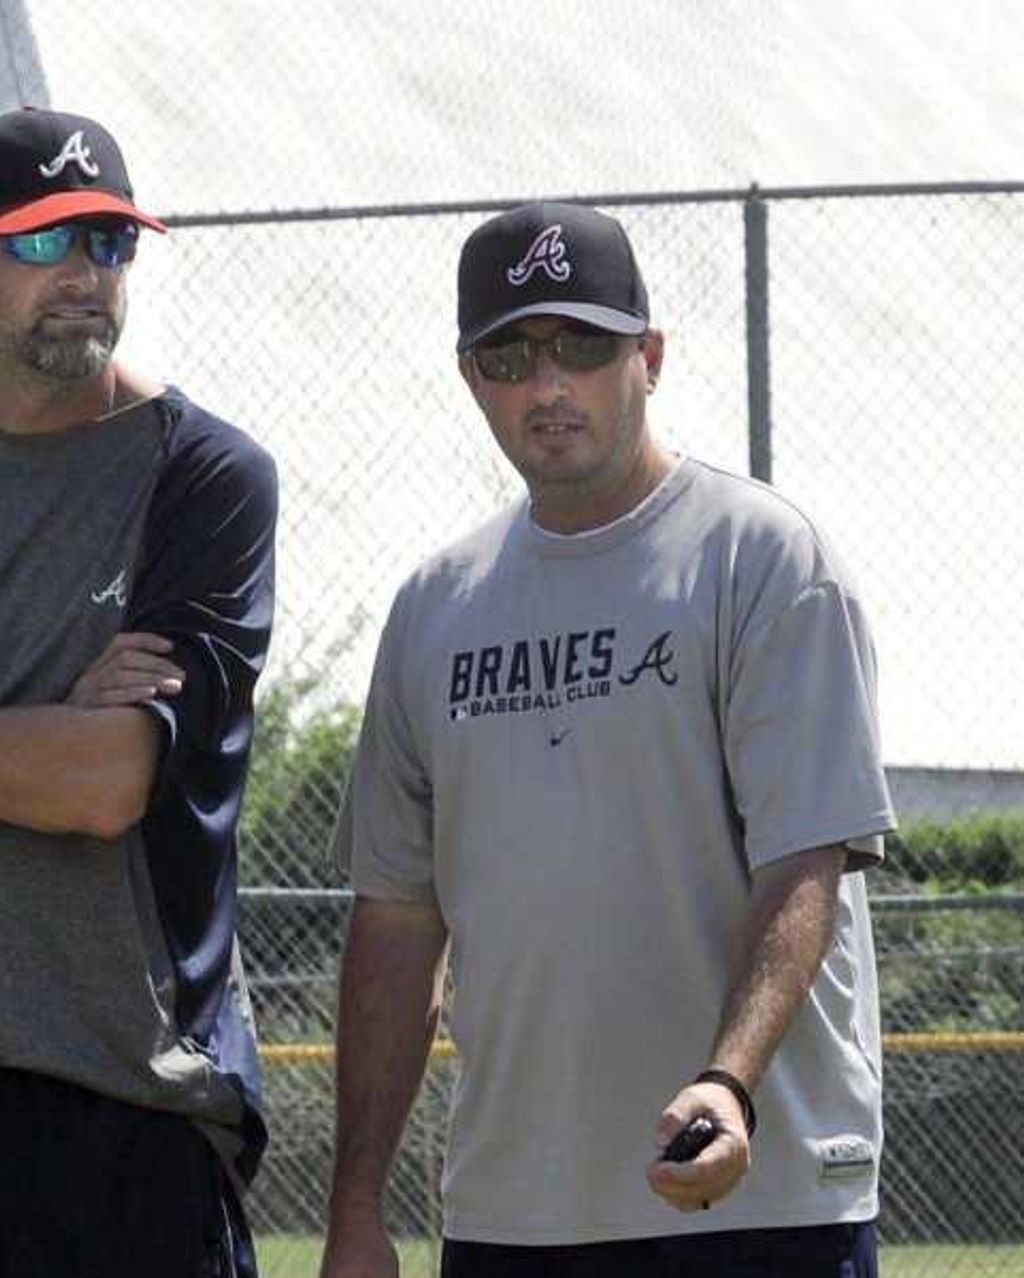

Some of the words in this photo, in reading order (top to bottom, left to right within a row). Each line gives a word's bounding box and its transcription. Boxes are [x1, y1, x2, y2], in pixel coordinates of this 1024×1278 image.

[38, 130, 100, 178] A
[508, 224, 570, 285] A
[449, 627, 616, 703] BRAVES
[618, 630, 677, 686] A
[566, 680, 611, 702] CLUB
